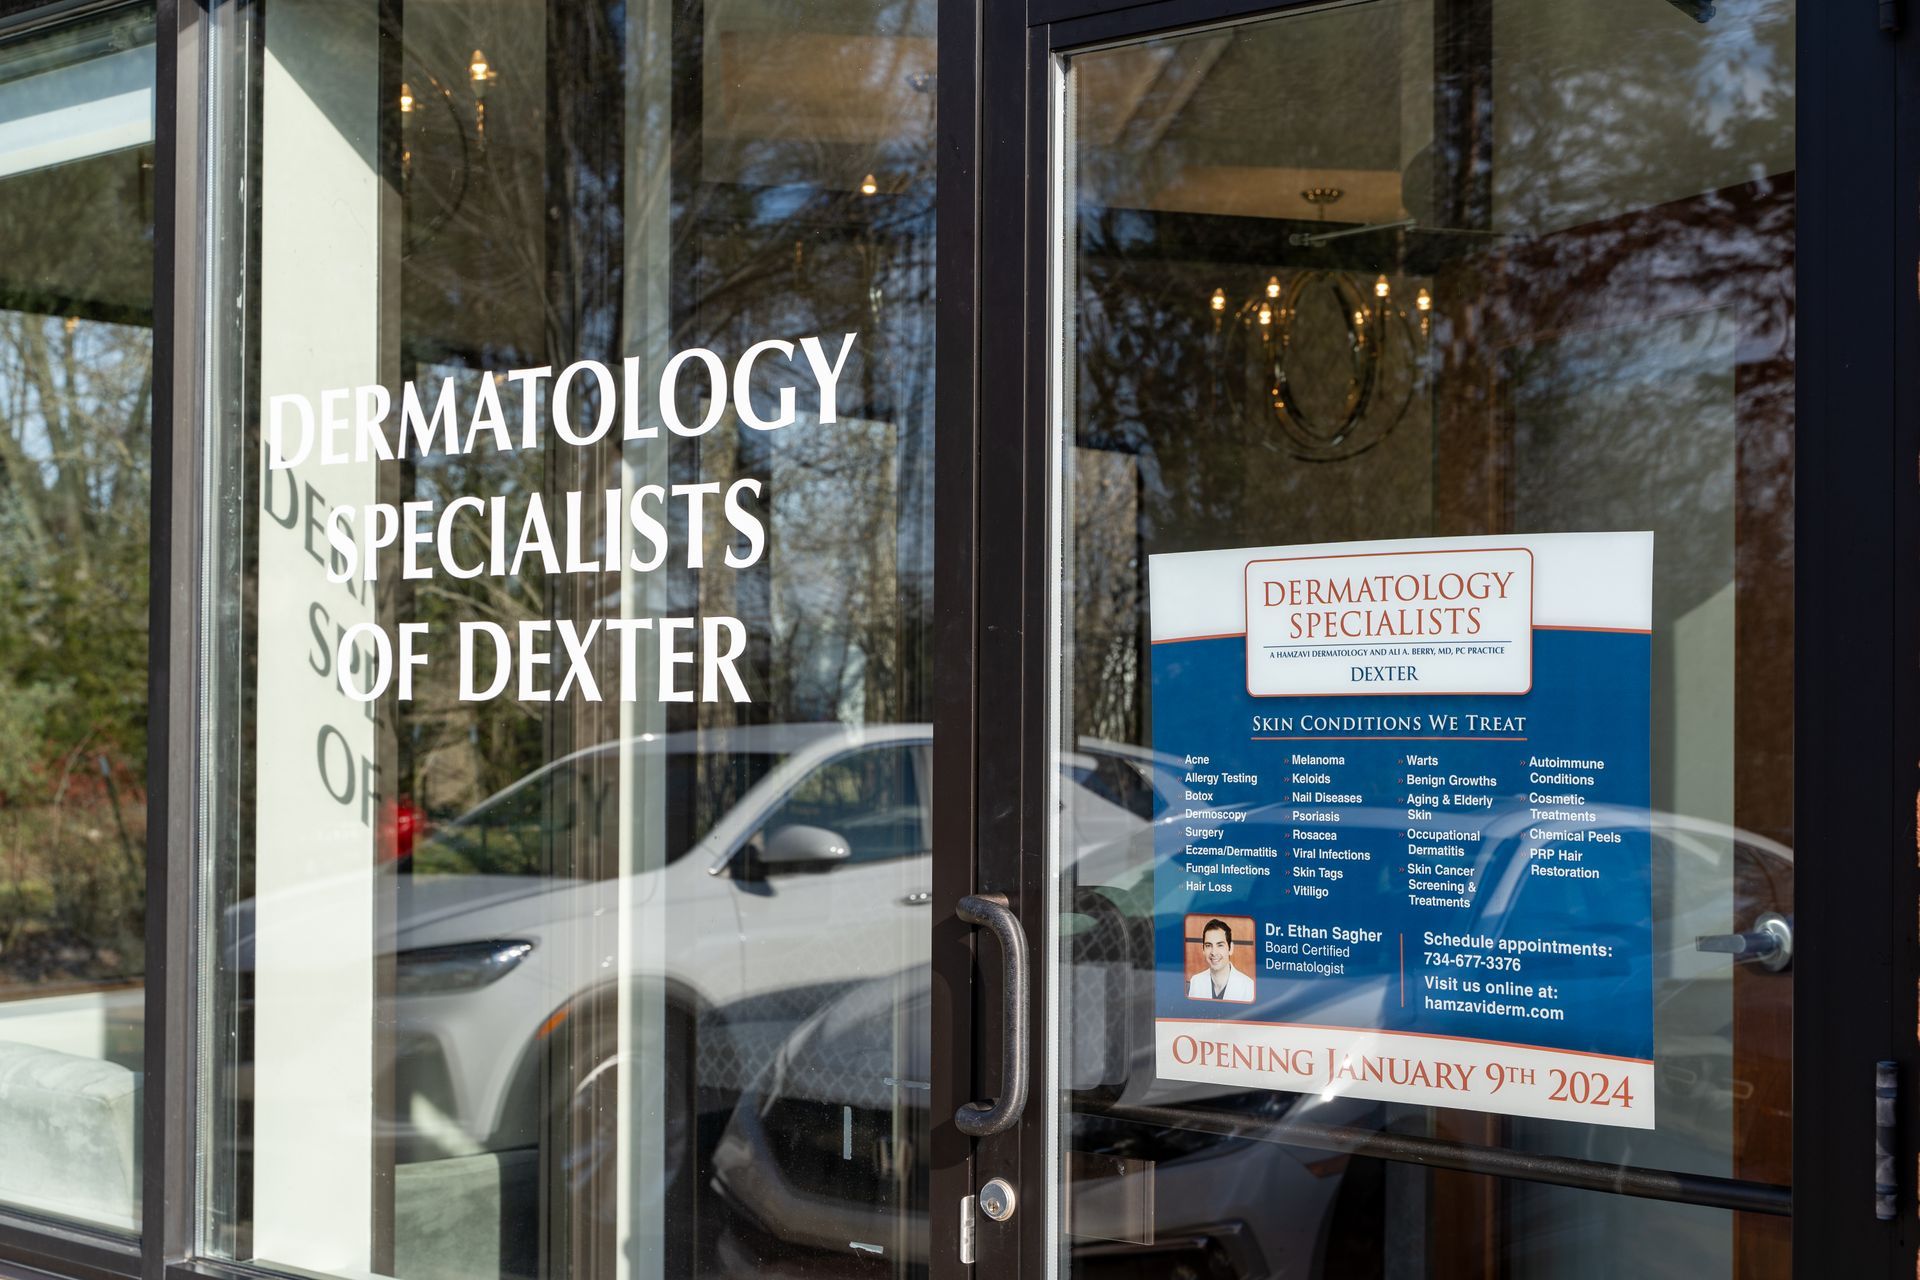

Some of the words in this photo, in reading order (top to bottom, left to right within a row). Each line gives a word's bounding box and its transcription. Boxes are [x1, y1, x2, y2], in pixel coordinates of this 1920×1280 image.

[268, 332, 857, 471] DERMATOLOGY
[325, 477, 765, 583] SPECIALISTS
[1264, 572, 1514, 608] DERMATOLOGY
[1291, 607, 1480, 638] SPECIALISTS
[1277, 651, 1310, 659] HAMZAVI
[1312, 649, 1368, 658] DERMATOLOGY
[1412, 648, 1437, 656] BERRY,
[1468, 647, 1505, 655] PRACTICE
[336, 620, 430, 704] OF
[458, 616, 752, 704] DEXTER
[1352, 666, 1418, 681] DEXTER
[1253, 716, 1292, 731] SKIN
[1301, 715, 1421, 730] CONDITIONS
[1429, 715, 1457, 730] WE
[1466, 715, 1526, 731] TREAT
[1184, 755, 1209, 766] Acne
[1292, 755, 1344, 764] Melanoma
[1407, 755, 1438, 765] Warts
[1529, 756, 1604, 769] Autoimmune
[1185, 773, 1218, 785] Allergy
[1222, 773, 1257, 785] Testing
[1293, 774, 1330, 783] Keloids
[1407, 774, 1445, 787] Benign
[1449, 775, 1496, 786] Growths
[1530, 773, 1594, 785] Conditions
[1185, 791, 1213, 800] Botox
[1293, 792, 1311, 802] Nail
[1315, 793, 1362, 803] Diseases
[1407, 794, 1438, 807] Aging
[1443, 795, 1450, 804] &
[1454, 795, 1493, 808] Elderly
[1530, 793, 1584, 806] Cosmetic
[1185, 809, 1246, 821] Dermoscopy
[1293, 811, 1340, 821] Psoriasis
[1408, 809, 1431, 820] Skin
[1530, 809, 1596, 822] Treatments
[1185, 827, 1223, 839] Surgery
[1293, 829, 1337, 840] Rosacea
[1407, 828, 1480, 842] Occupational
[1529, 828, 1585, 842] Chemical
[1589, 831, 1621, 843] Peels
[1186, 845, 1277, 857] Eczema/Dermatitis
[1293, 848, 1315, 858] Viral
[1319, 849, 1370, 860] Infections
[1409, 844, 1464, 856] Dermatitis
[1529, 848, 1554, 859] PRP
[1559, 850, 1583, 861] Hair
[1186, 863, 1218, 875] Fungal
[1222, 864, 1270, 875] Infections
[1293, 867, 1315, 877] Skin
[1320, 868, 1343, 880] Tags
[1408, 863, 1431, 874] Skin
[1435, 864, 1475, 876] Cancer
[1531, 864, 1599, 878] Restoration
[1187, 881, 1205, 890] Hair
[1209, 882, 1232, 892] Loss
[1293, 886, 1328, 899] Vitiligo
[1409, 879, 1464, 894] Screening
[1468, 882, 1476, 892] &
[1409, 895, 1471, 907] Treatments
[1266, 923, 1283, 936] Dr.
[1288, 924, 1327, 938] Ethan
[1333, 927, 1382, 944] Sagher
[1266, 941, 1297, 954] Board
[1302, 944, 1349, 957] Certified
[1424, 932, 1494, 949] Schedule
[1498, 939, 1612, 959] appointments:
[1266, 958, 1344, 976] Dermatologist
[1424, 951, 1521, 971] 734-677-3376
[1425, 976, 1457, 990] Visit
[1463, 982, 1480, 992] us
[1486, 982, 1533, 997] online
[1539, 986, 1557, 998] at:
[1425, 996, 1563, 1020] hamzaviderm.com
[1172, 1035, 1313, 1075] OPENING
[1326, 1048, 1477, 1092] JANUARY
[1486, 1063, 1535, 1094] 9TH
[1548, 1069, 1633, 1108] 2024
